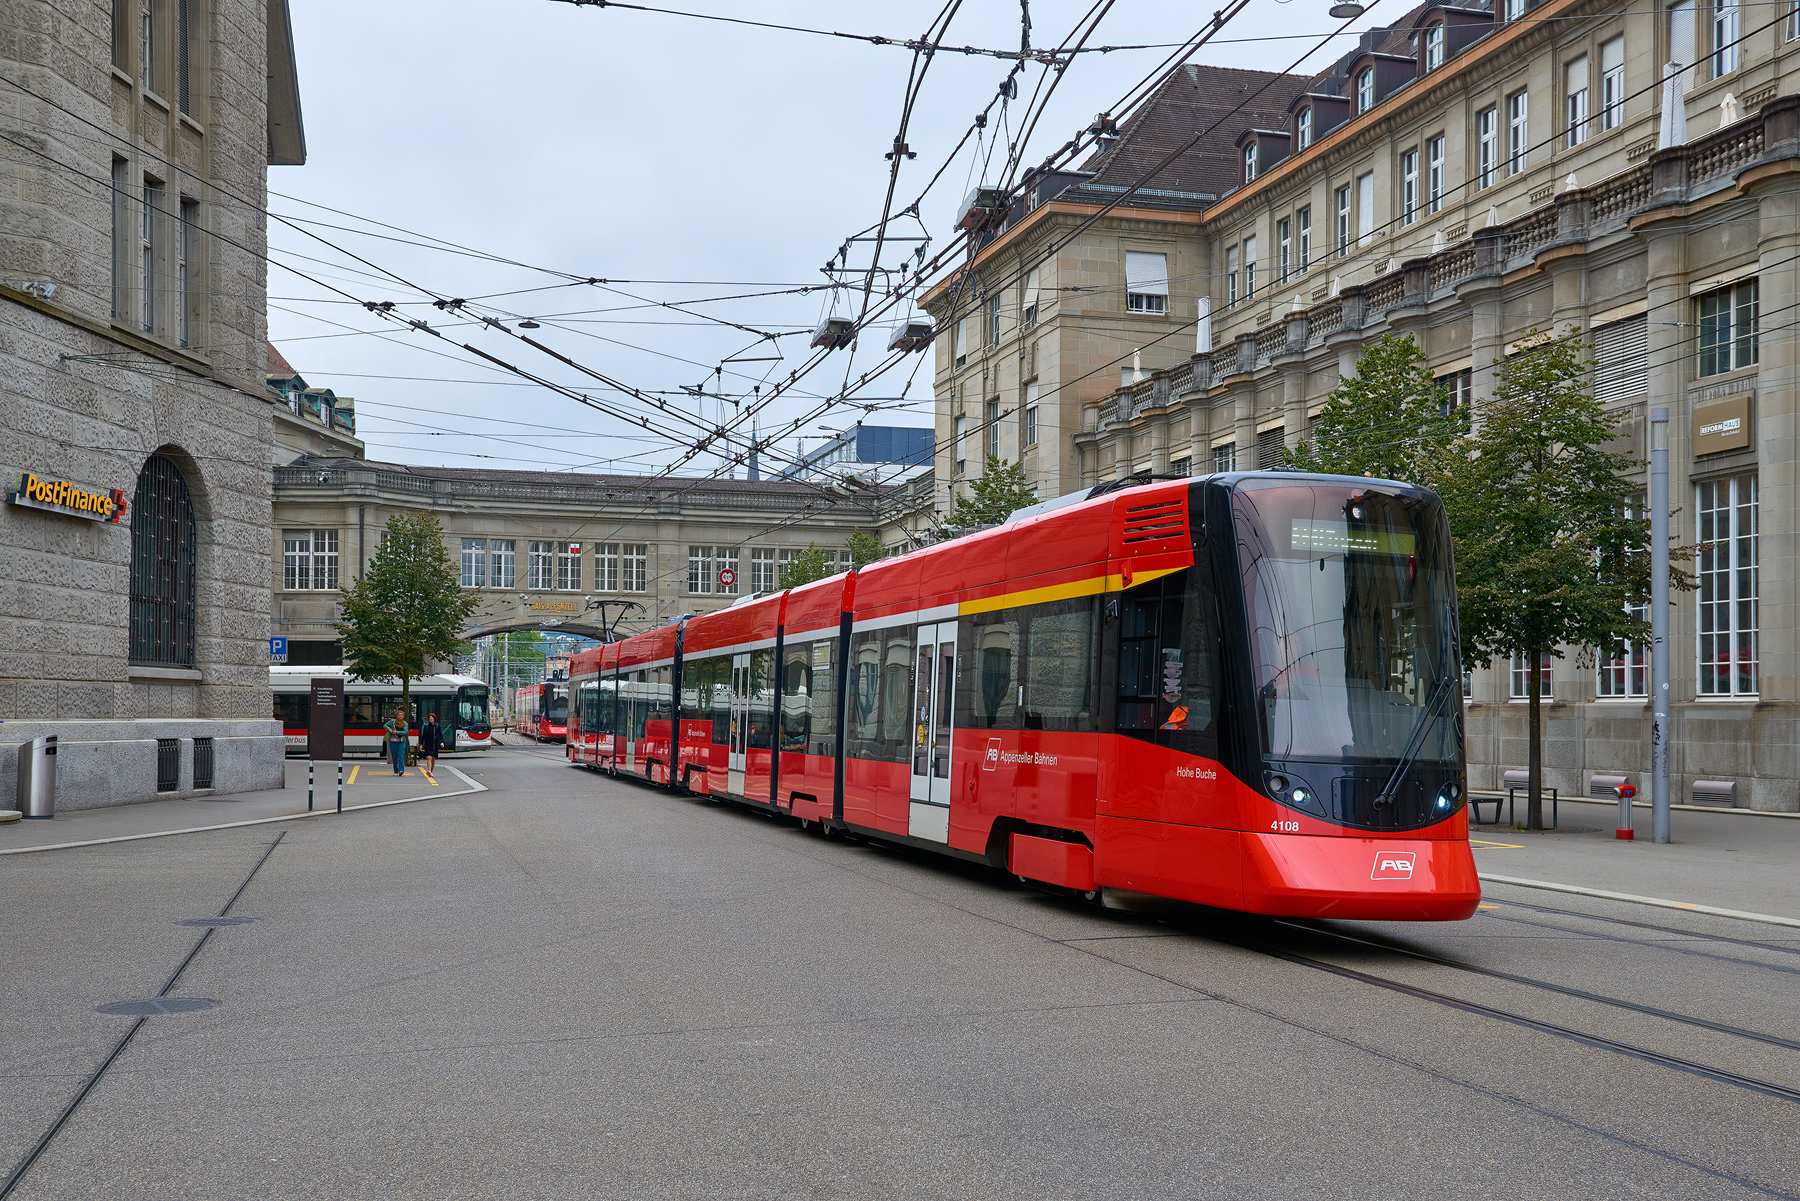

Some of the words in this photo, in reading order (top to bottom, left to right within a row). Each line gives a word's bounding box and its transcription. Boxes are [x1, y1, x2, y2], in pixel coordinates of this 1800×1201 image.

[25, 474, 112, 516] PostFinance
[546, 602, 578, 610] APPENZELL
[272, 640, 282, 652] P
[986, 748, 998, 761] AB
[1000, 750, 1033, 764] Appenzeller
[1034, 752, 1058, 766] Bahnen
[1176, 766, 1194, 778] Hohe
[1196, 767, 1216, 780] Buche
[1270, 820, 1300, 832] 4108
[1380, 860, 1413, 871] AB
